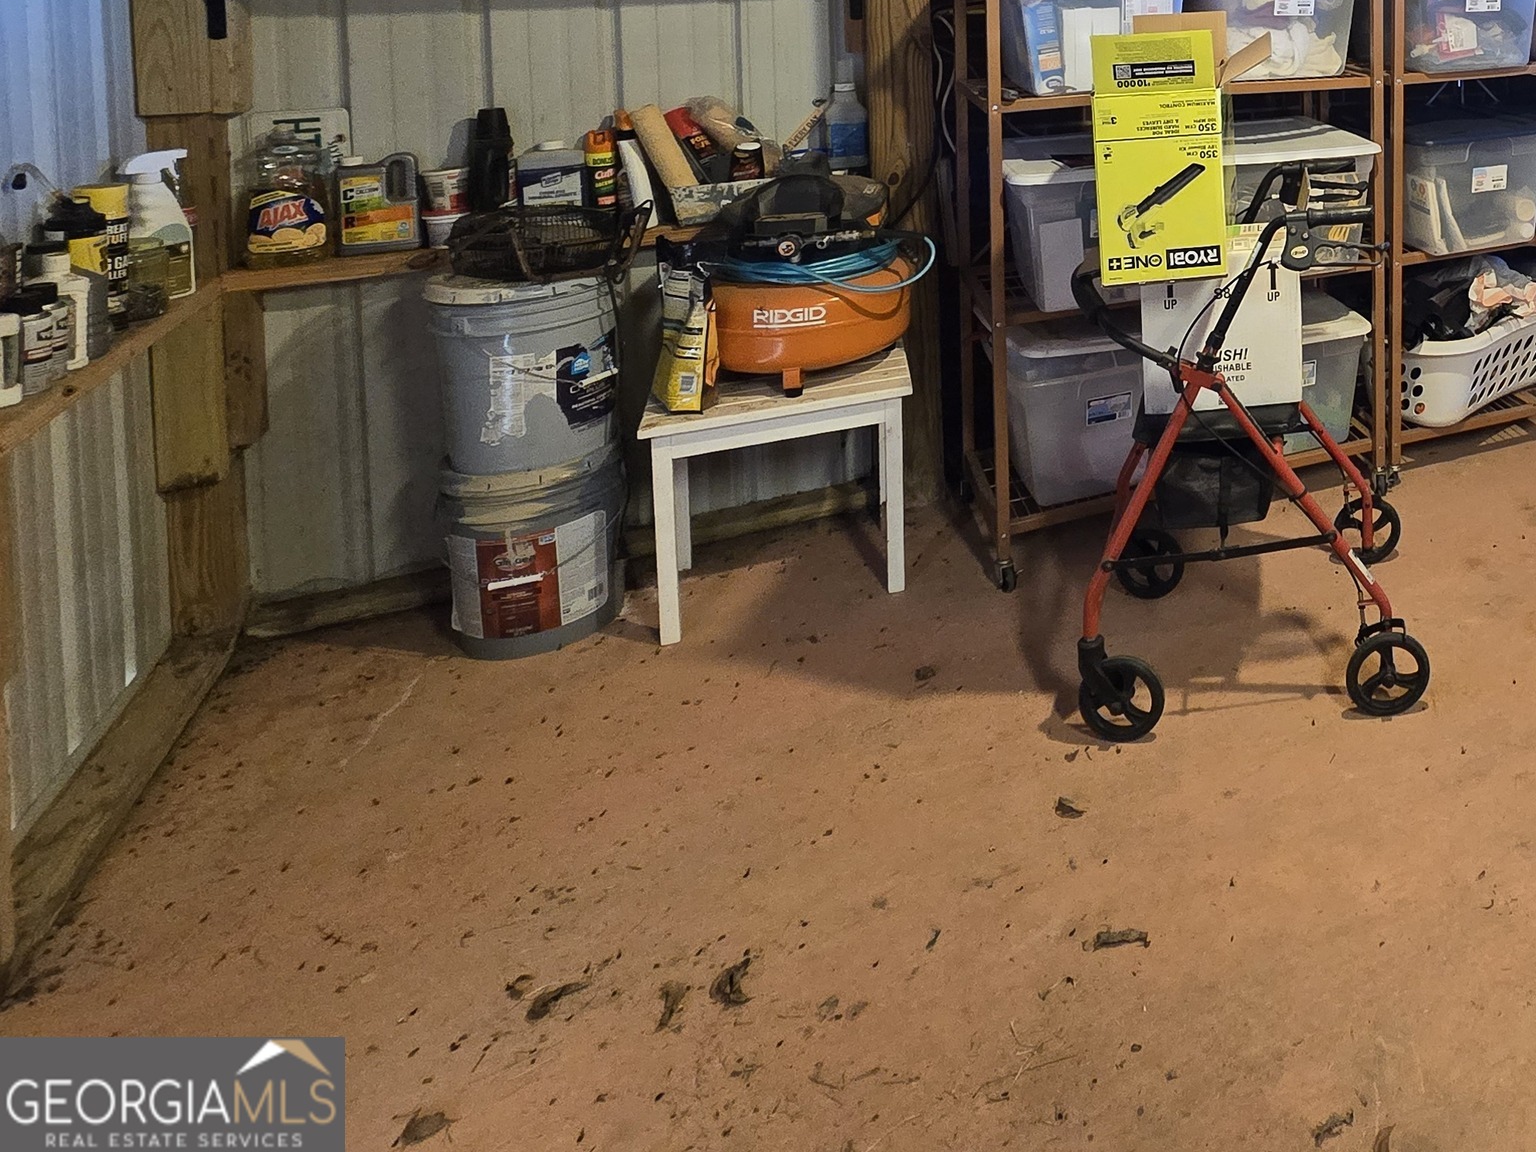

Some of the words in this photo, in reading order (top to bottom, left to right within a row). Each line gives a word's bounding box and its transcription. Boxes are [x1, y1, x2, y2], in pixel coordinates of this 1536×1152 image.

[1197, 123, 1217, 132] 350
[1199, 150, 1218, 159] 350
[343, 188, 355, 201] C
[258, 199, 307, 230] AJAX
[1169, 248, 1219, 265] RYOBI
[1267, 291, 1281, 302] UP
[1163, 299, 1177, 310] UP
[753, 305, 827, 325] RIDGID
